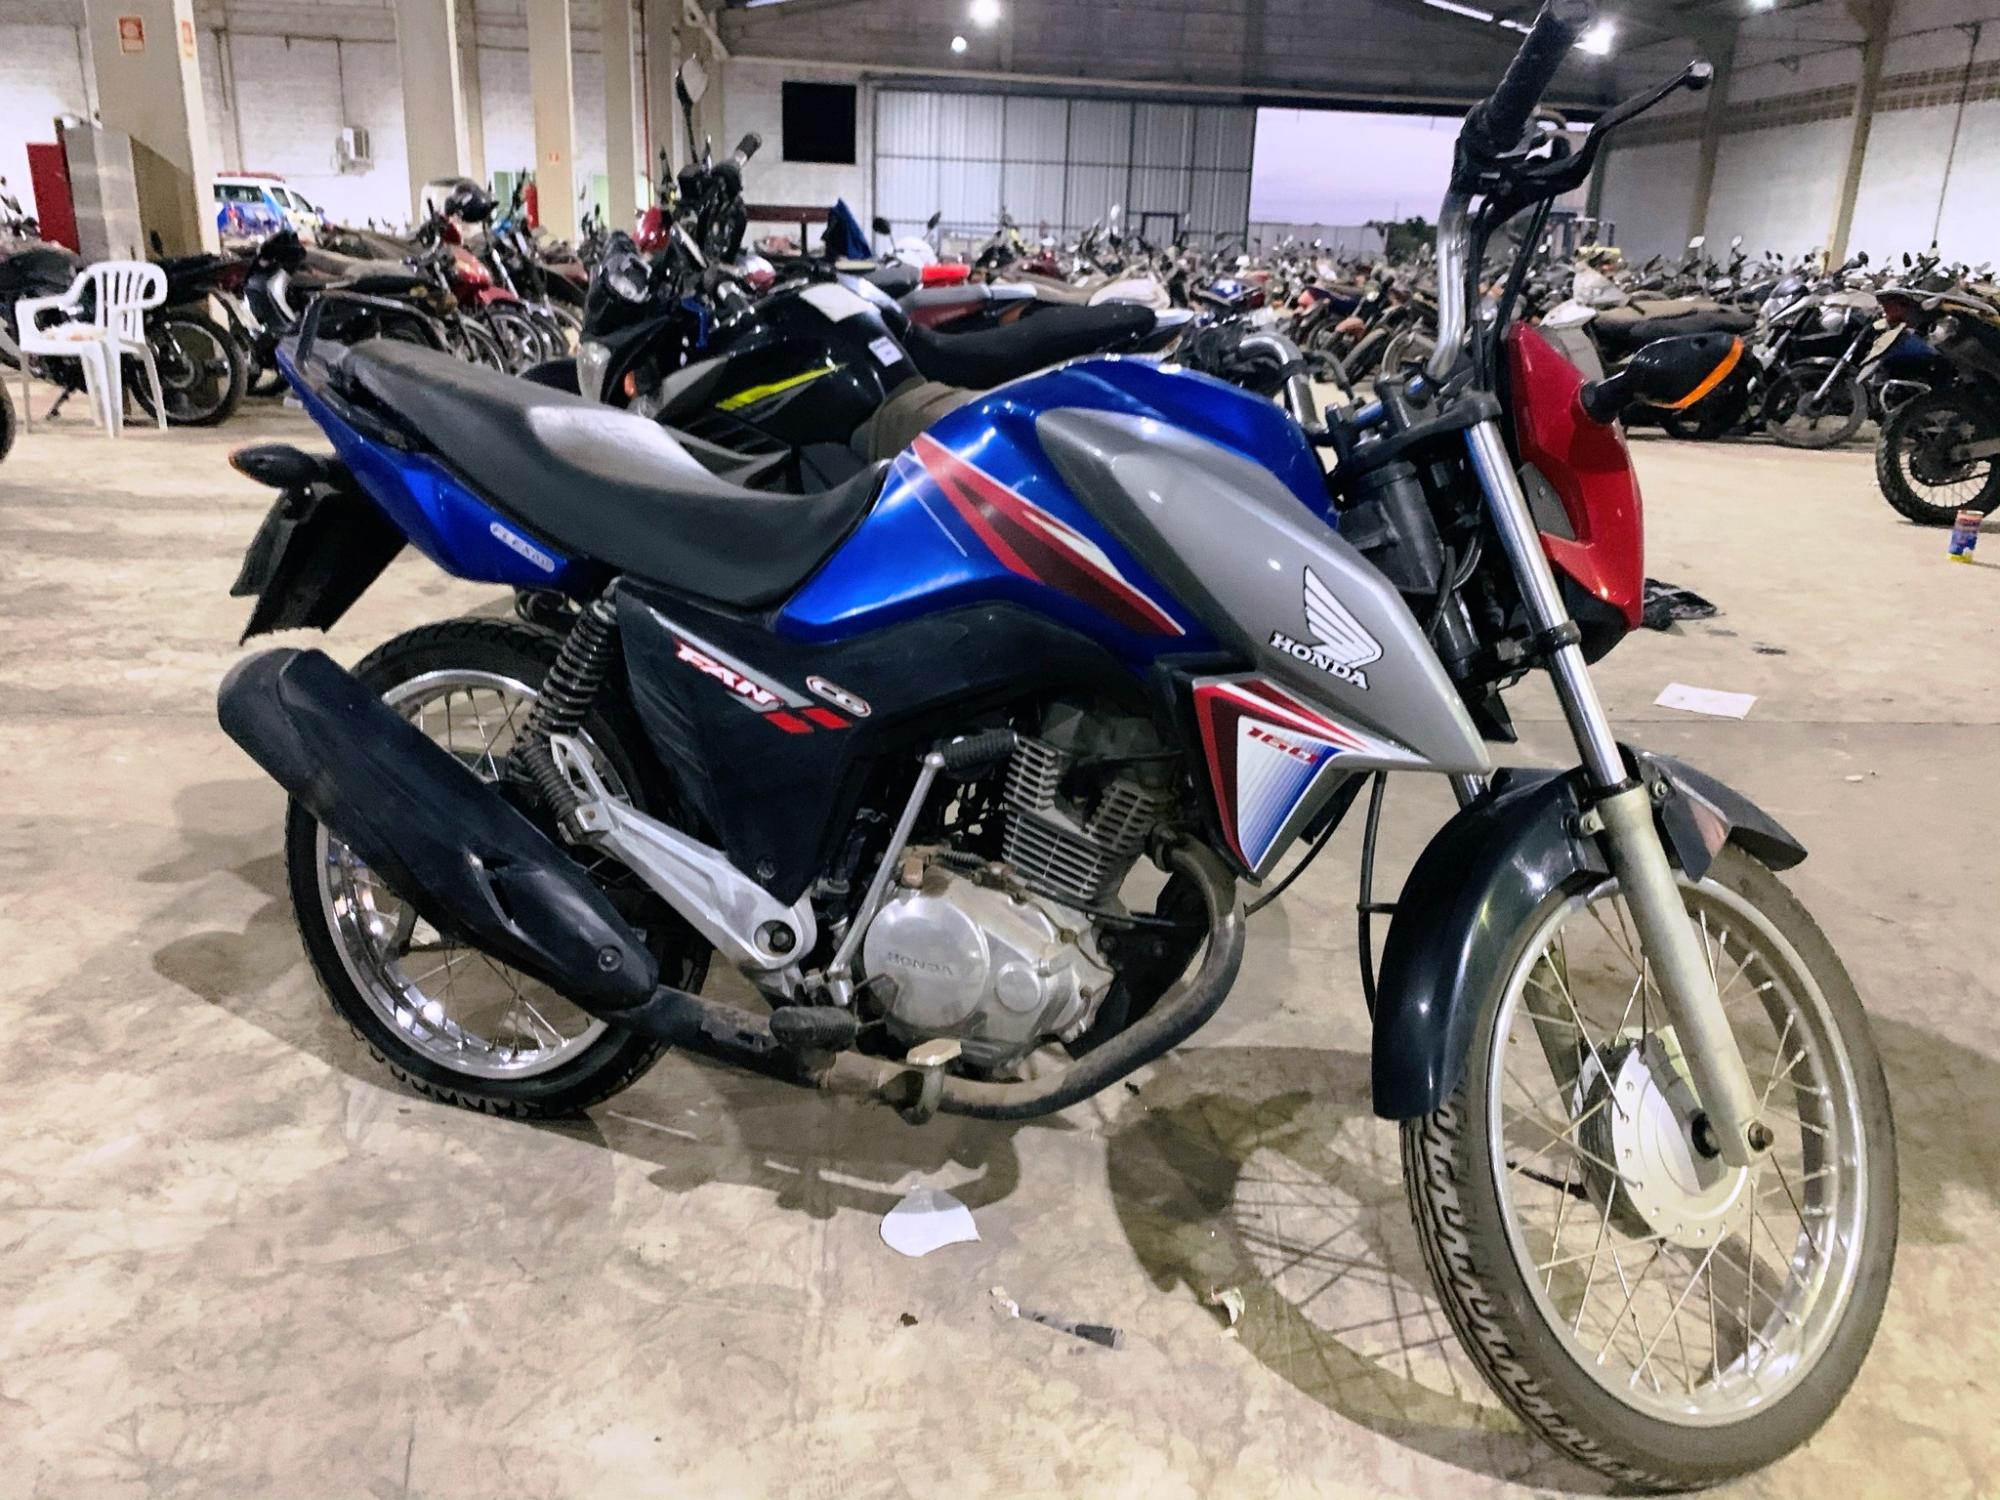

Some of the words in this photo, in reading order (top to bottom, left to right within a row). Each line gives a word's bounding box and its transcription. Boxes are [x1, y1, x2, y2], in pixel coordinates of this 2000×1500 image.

[675, 640, 780, 706] FAN
[1269, 631, 1370, 691] HONDA
[1246, 725, 1320, 766] 160
[887, 951, 954, 976] HONDA
